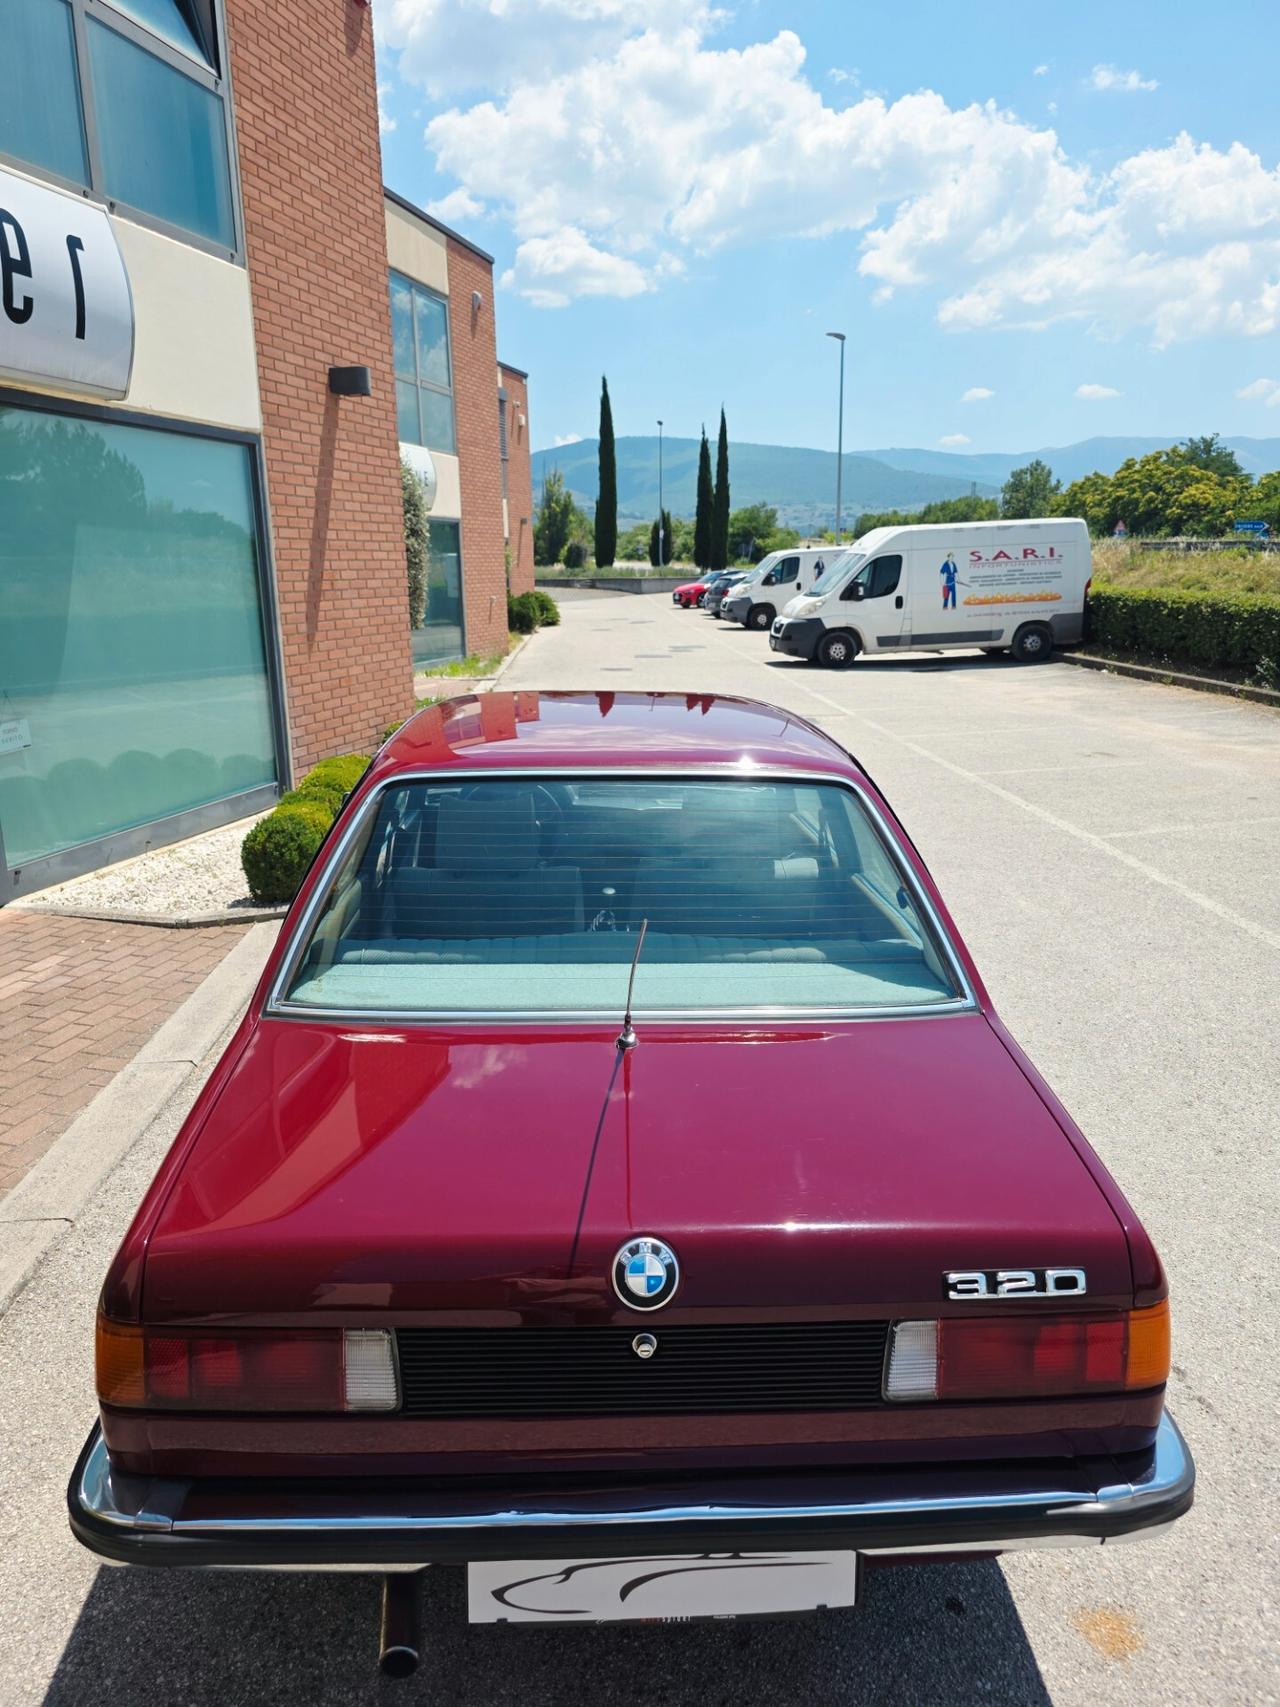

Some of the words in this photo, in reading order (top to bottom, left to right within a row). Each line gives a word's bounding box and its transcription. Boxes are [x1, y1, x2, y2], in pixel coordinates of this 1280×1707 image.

[969, 547, 1063, 562] S.A.R.I.
[619, 1242, 672, 1266] BMW
[947, 1269, 1086, 1300] 320
